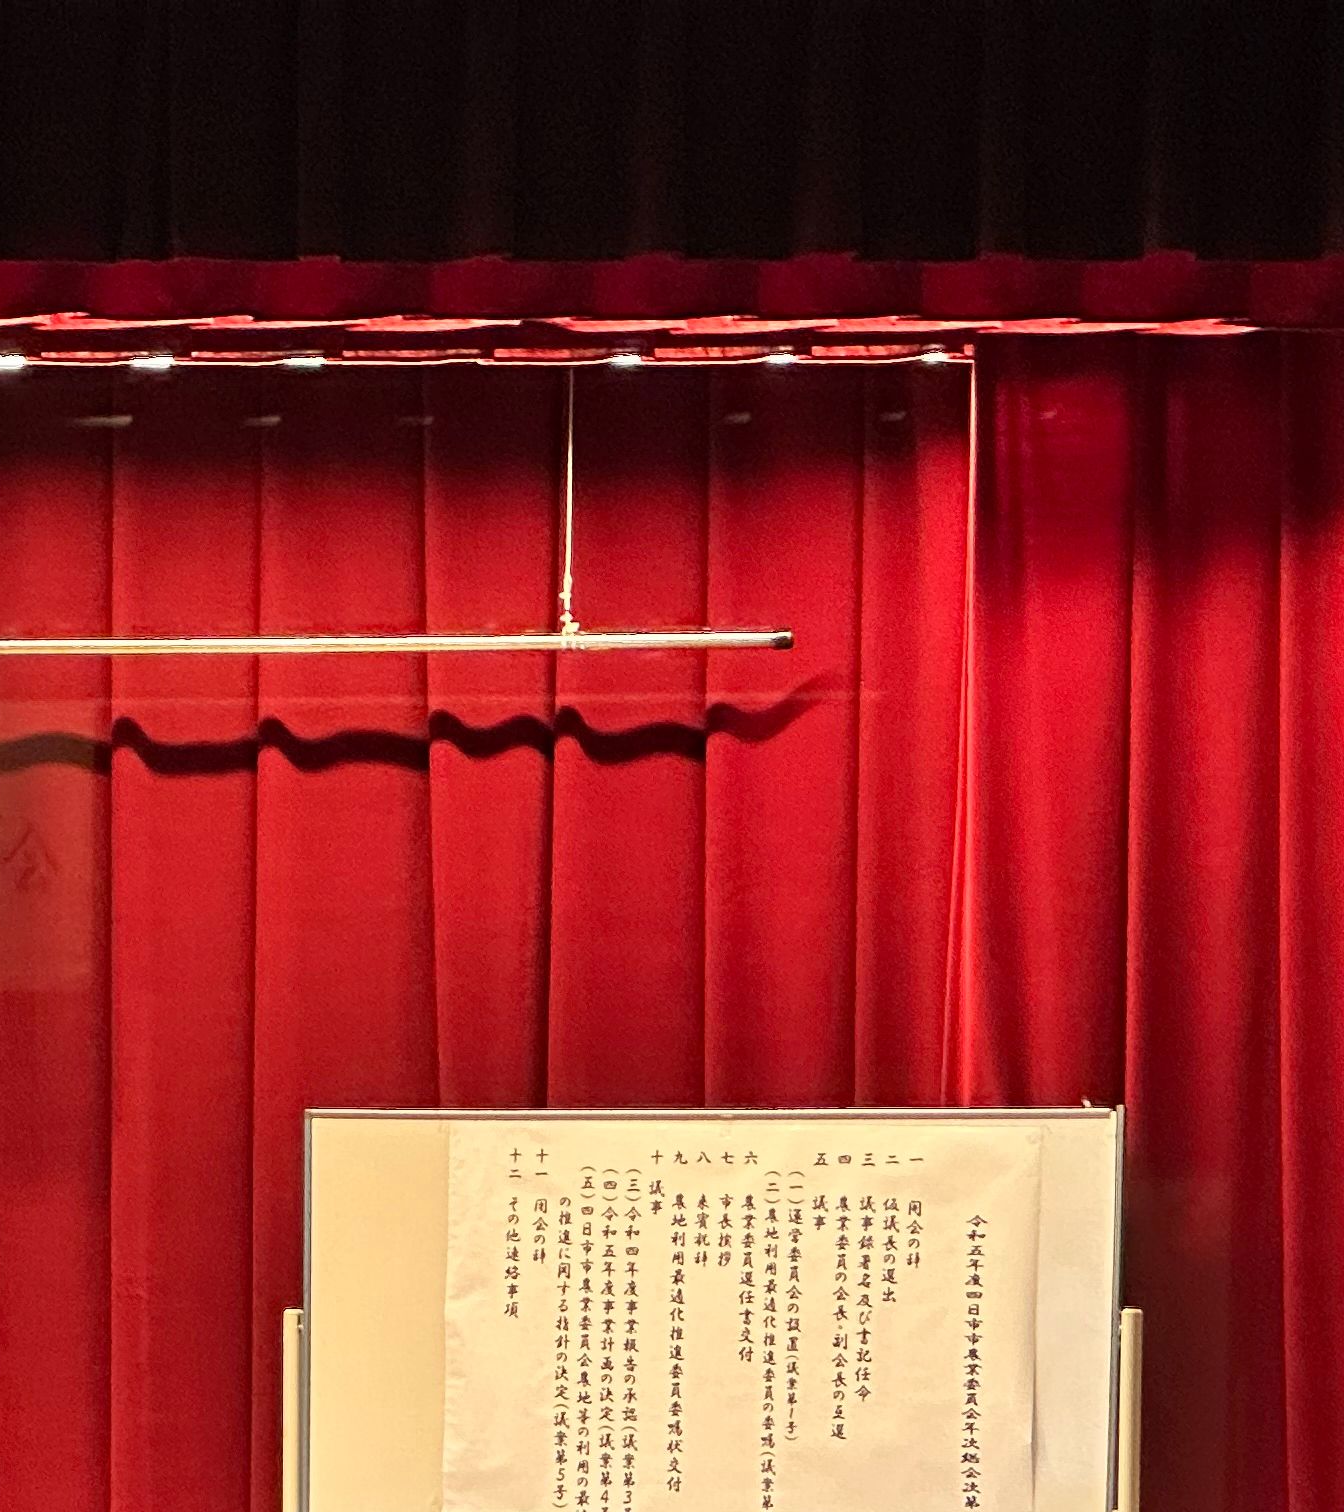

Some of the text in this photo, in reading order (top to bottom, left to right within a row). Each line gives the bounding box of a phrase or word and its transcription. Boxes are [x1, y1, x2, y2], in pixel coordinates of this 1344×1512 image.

[648, 1149, 666, 1216] 十 議事
[673, 1150, 689, 1165] 九
[811, 1152, 829, 1231] 五 議事
[837, 1154, 852, 1165] 四
[861, 1152, 876, 1167] 三
[503, 1147, 523, 1319] 十二 その他連絡事項
[531, 1148, 549, 1265] 十一 閉会の辞
[693, 1151, 712, 1268] 八 来賓祝辞
[717, 1151, 735, 1267] 七 市長挨拶
[880, 1154, 901, 1303] 二 仮議長の選出
[906, 1200, 924, 1269] 開会の辞
[737, 1150, 758, 1363] 六 農業委員選任書交付
